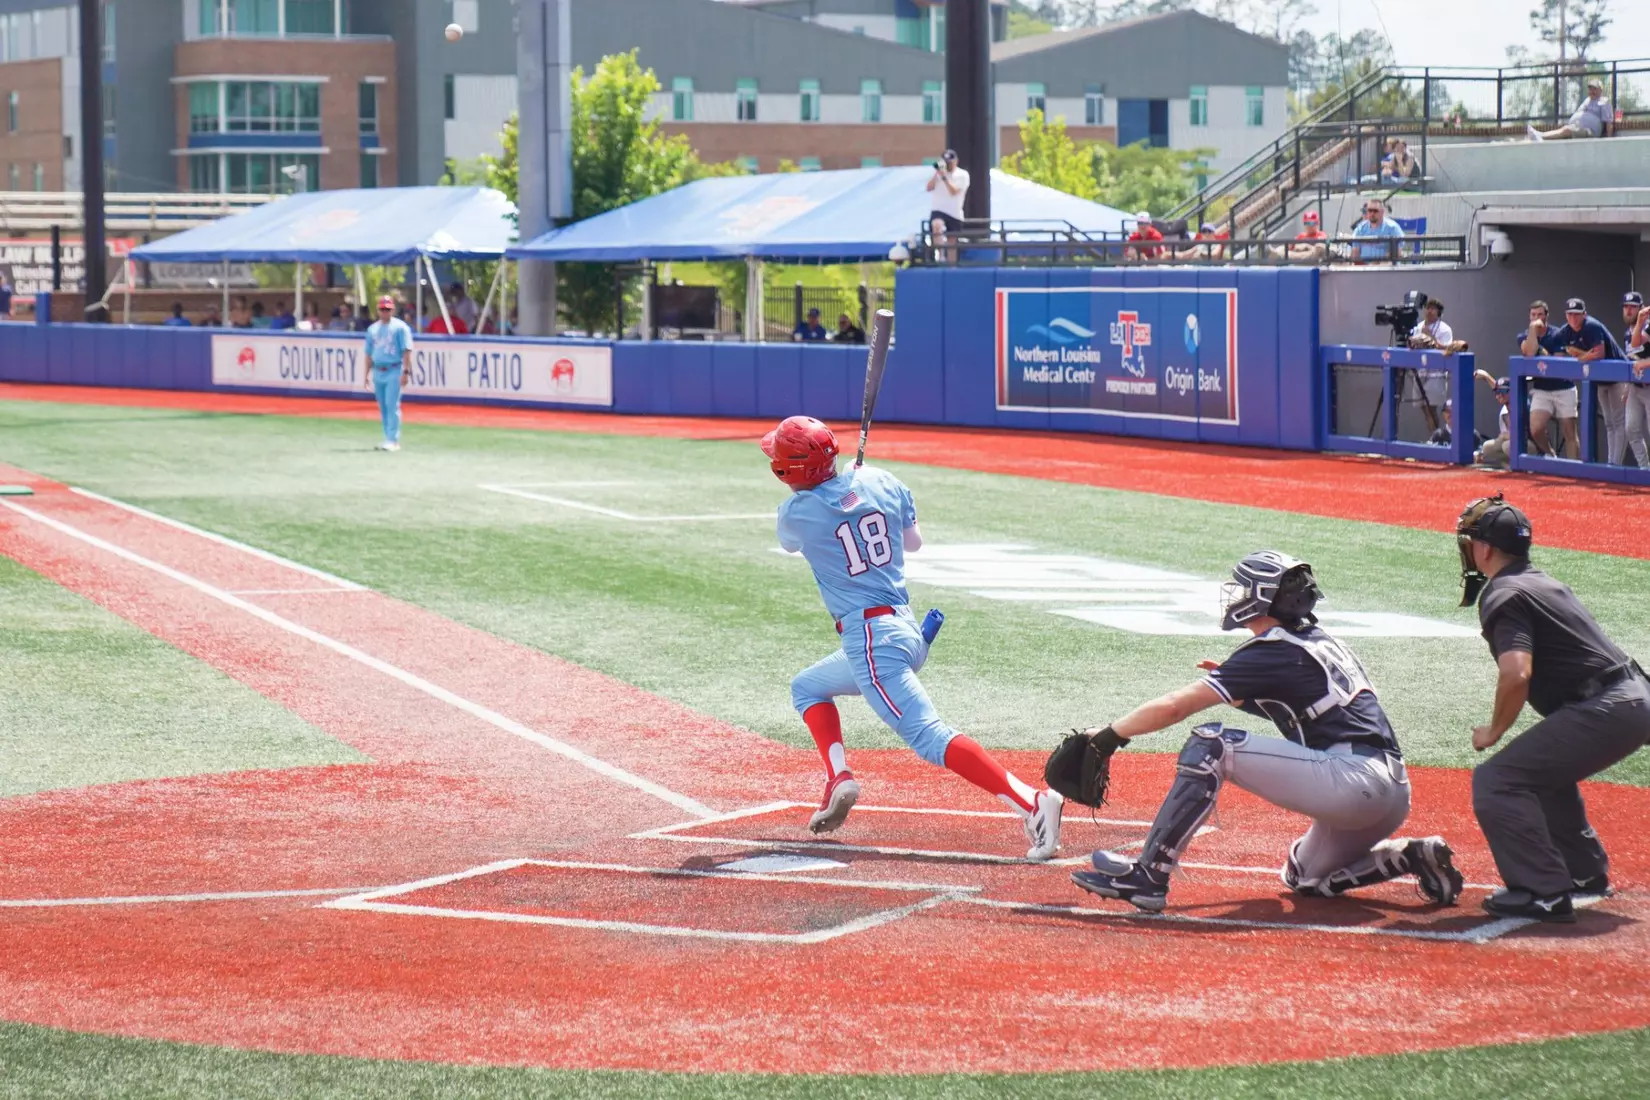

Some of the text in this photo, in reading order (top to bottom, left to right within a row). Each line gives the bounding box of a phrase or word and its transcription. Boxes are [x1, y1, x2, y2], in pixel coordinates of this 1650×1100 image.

[867, 324, 879, 372] EASTON
[1014, 345, 1060, 363] Northern
[279, 345, 357, 382] COUNTRY
[468, 352, 522, 390] PATIO
[1023, 365, 1064, 383] Medical
[1165, 365, 1195, 396] Origin
[835, 511, 892, 577] 18
